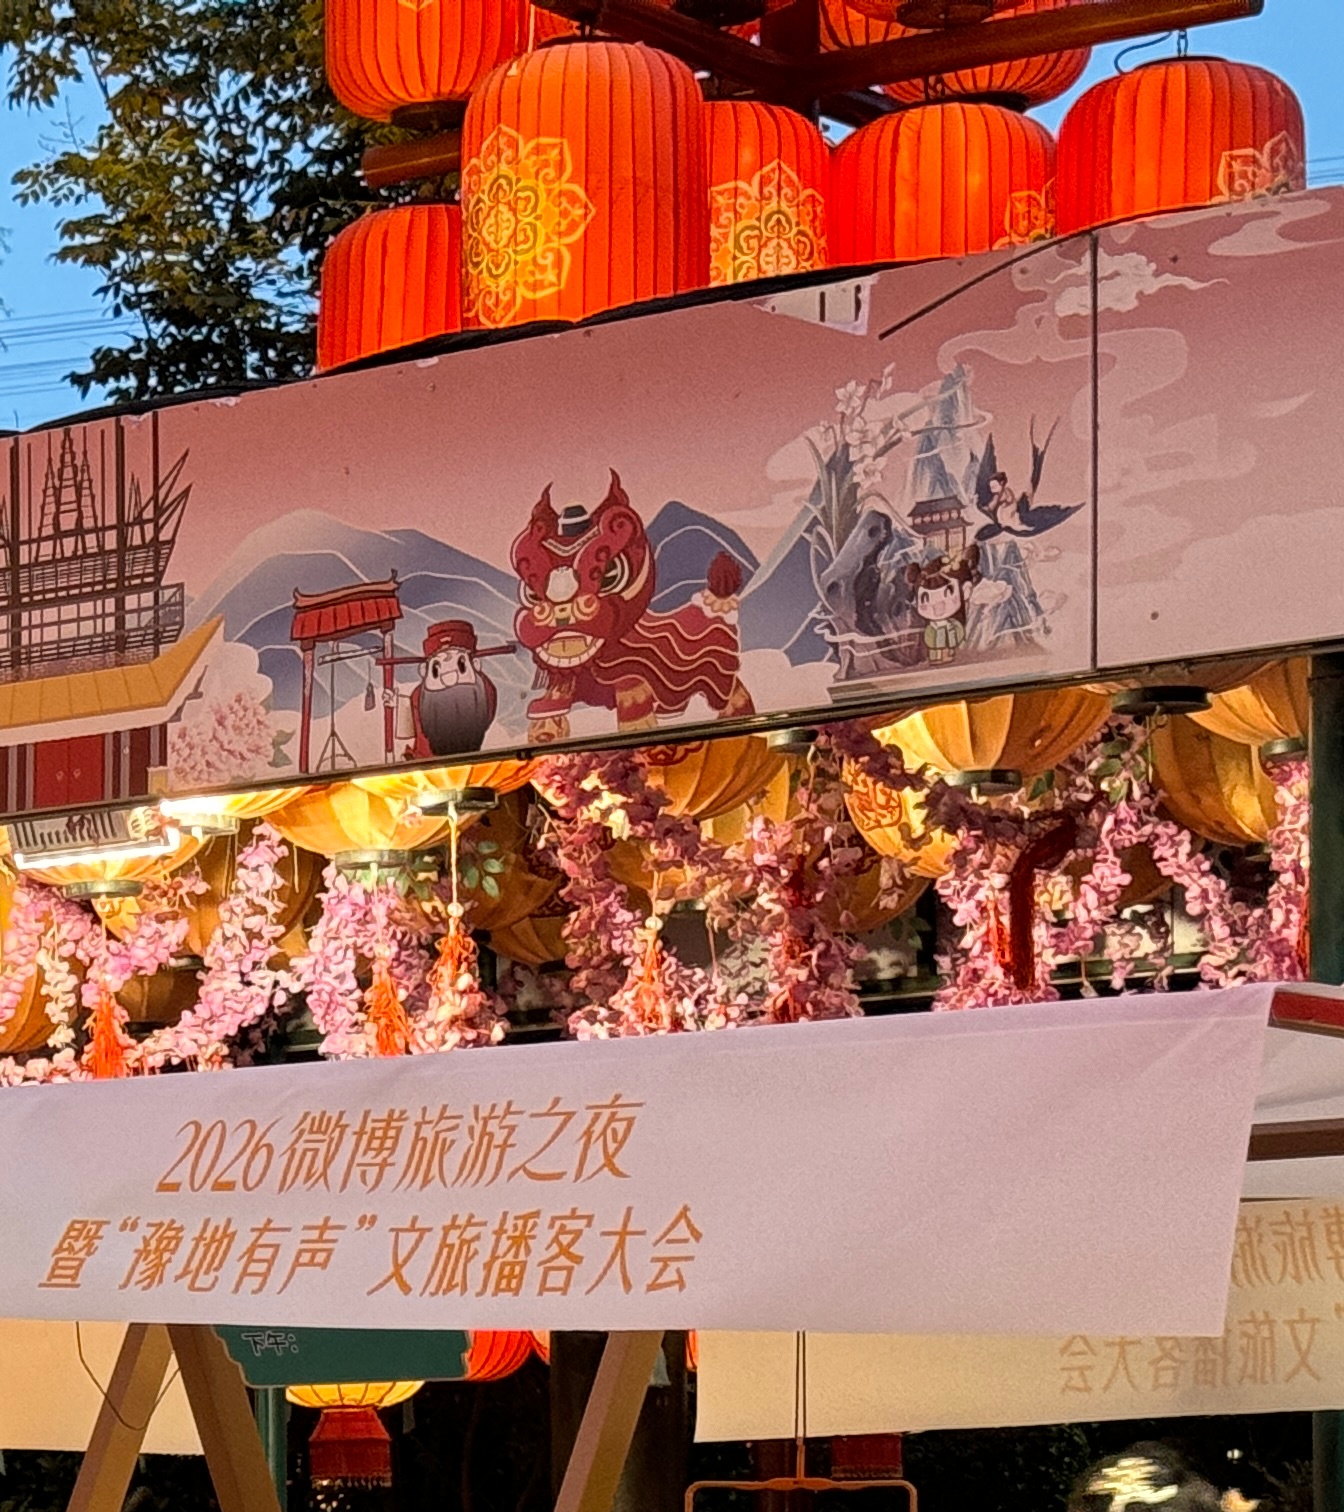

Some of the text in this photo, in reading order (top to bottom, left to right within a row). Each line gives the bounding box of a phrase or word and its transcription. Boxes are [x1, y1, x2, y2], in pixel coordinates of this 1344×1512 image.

[155, 1093, 647, 1195] 2026微博旅游之夜
